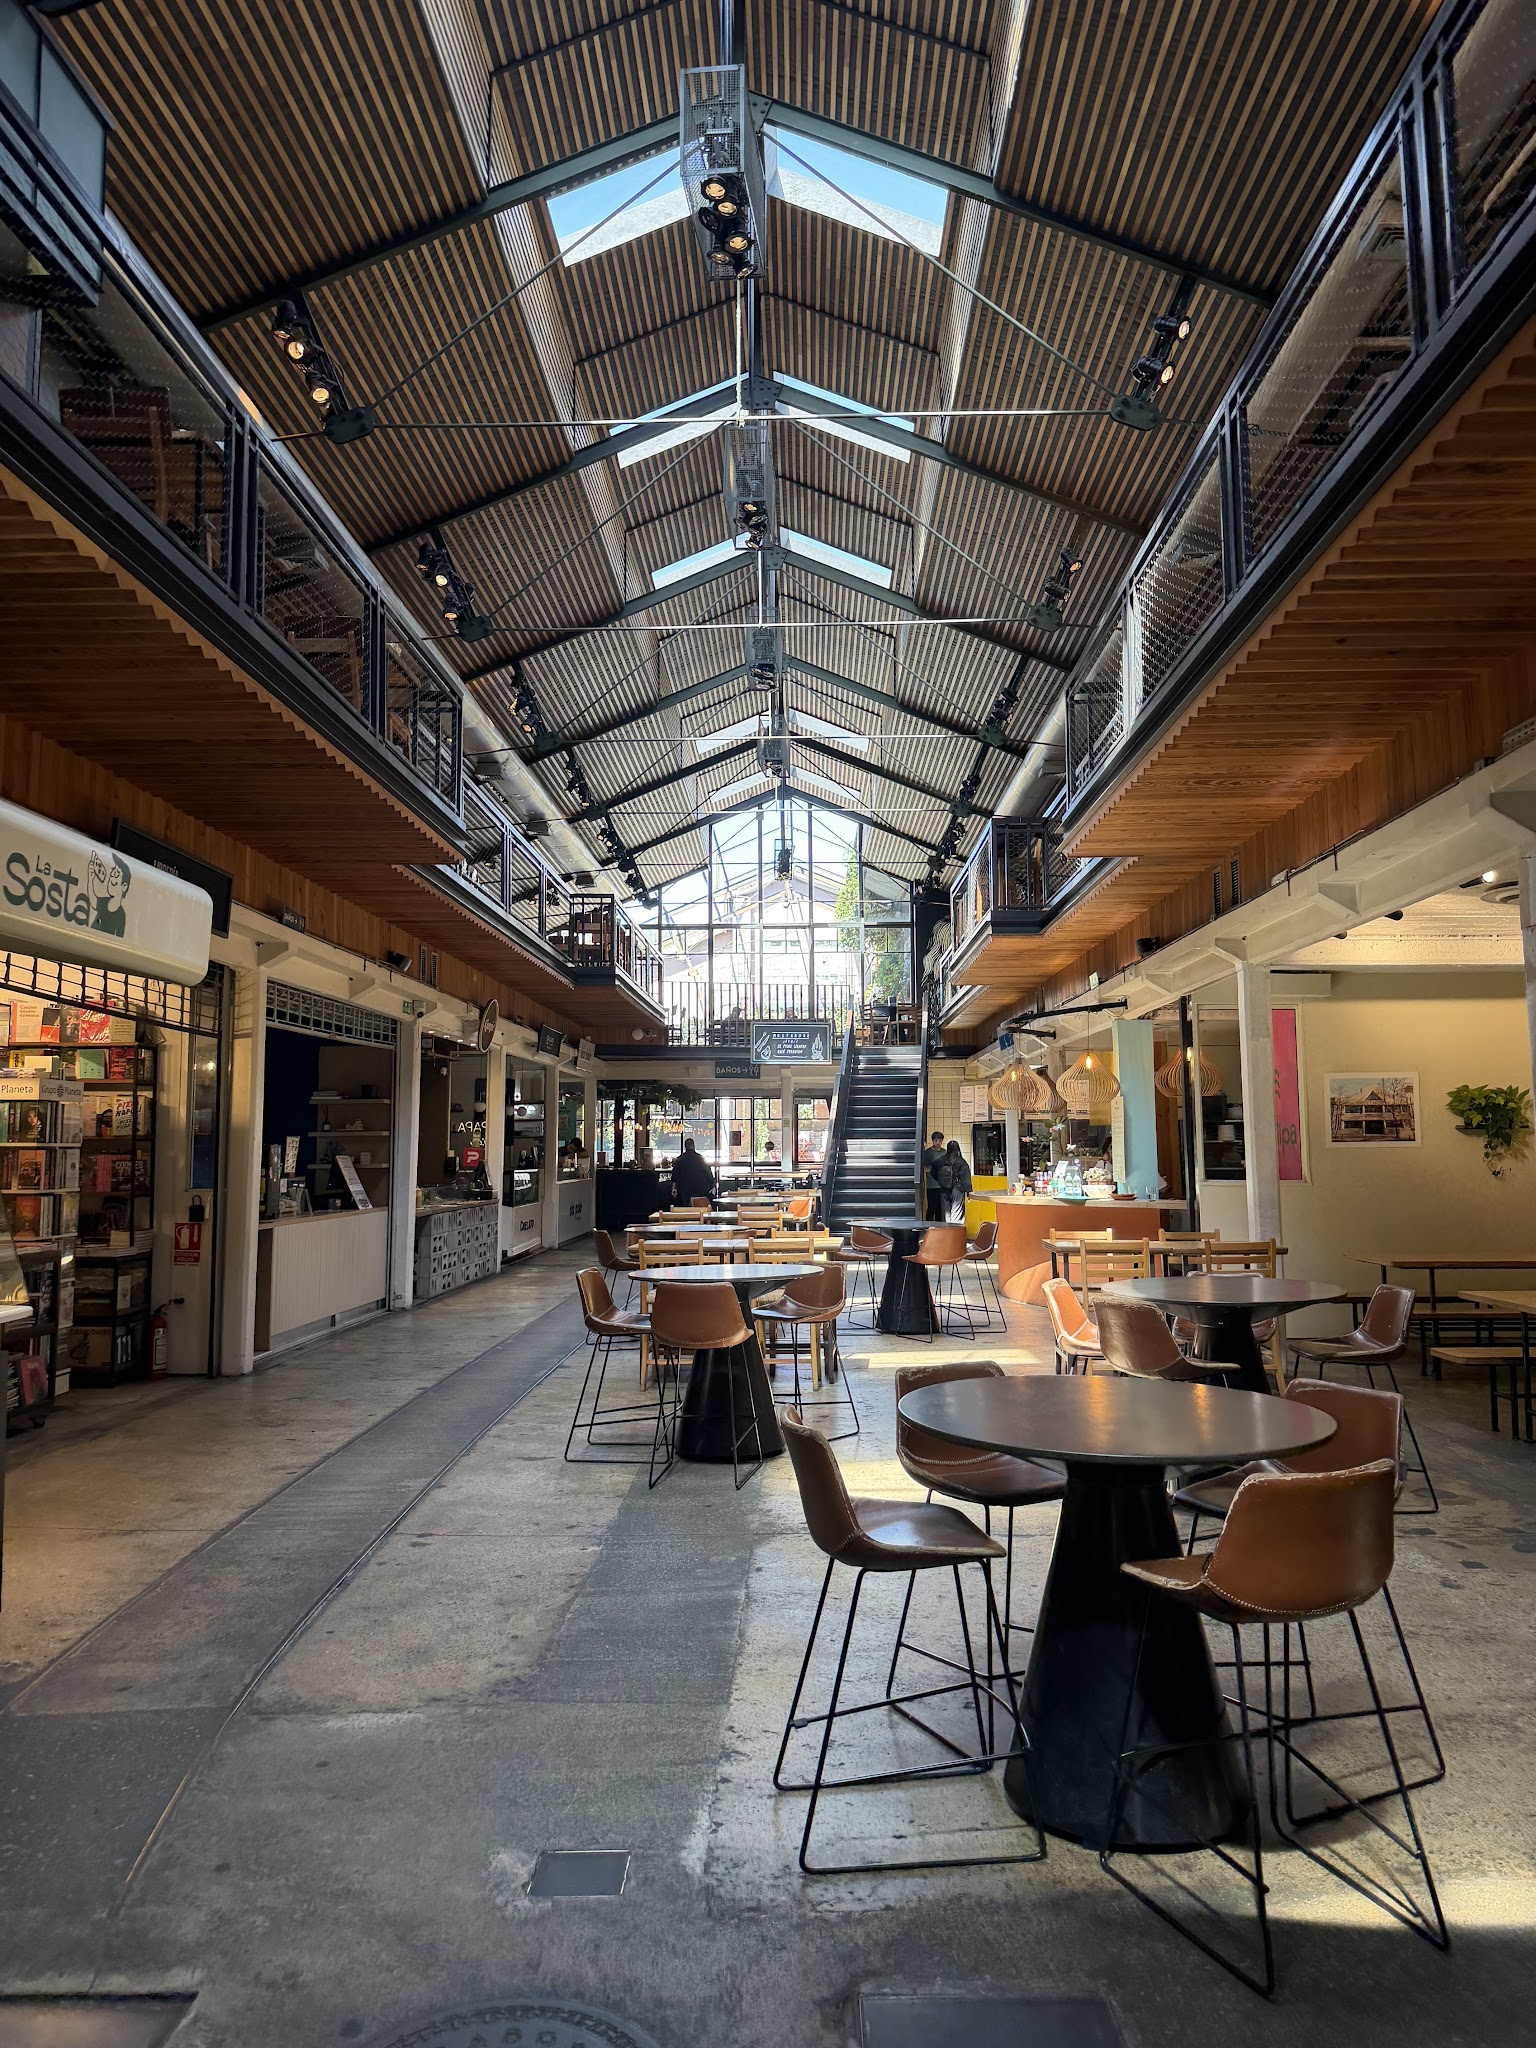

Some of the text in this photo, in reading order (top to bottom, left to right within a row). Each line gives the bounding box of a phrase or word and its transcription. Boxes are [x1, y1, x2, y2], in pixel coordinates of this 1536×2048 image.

[36, 855, 51, 876] La
[3, 852, 91, 927] Sosta
[716, 1065, 741, 1074] BAÑOS
[1, 1084, 34, 1094] Planeta
[41, 1084, 82, 1096] Grupo Planeta
[115, 1160, 144, 1170] COOKES
